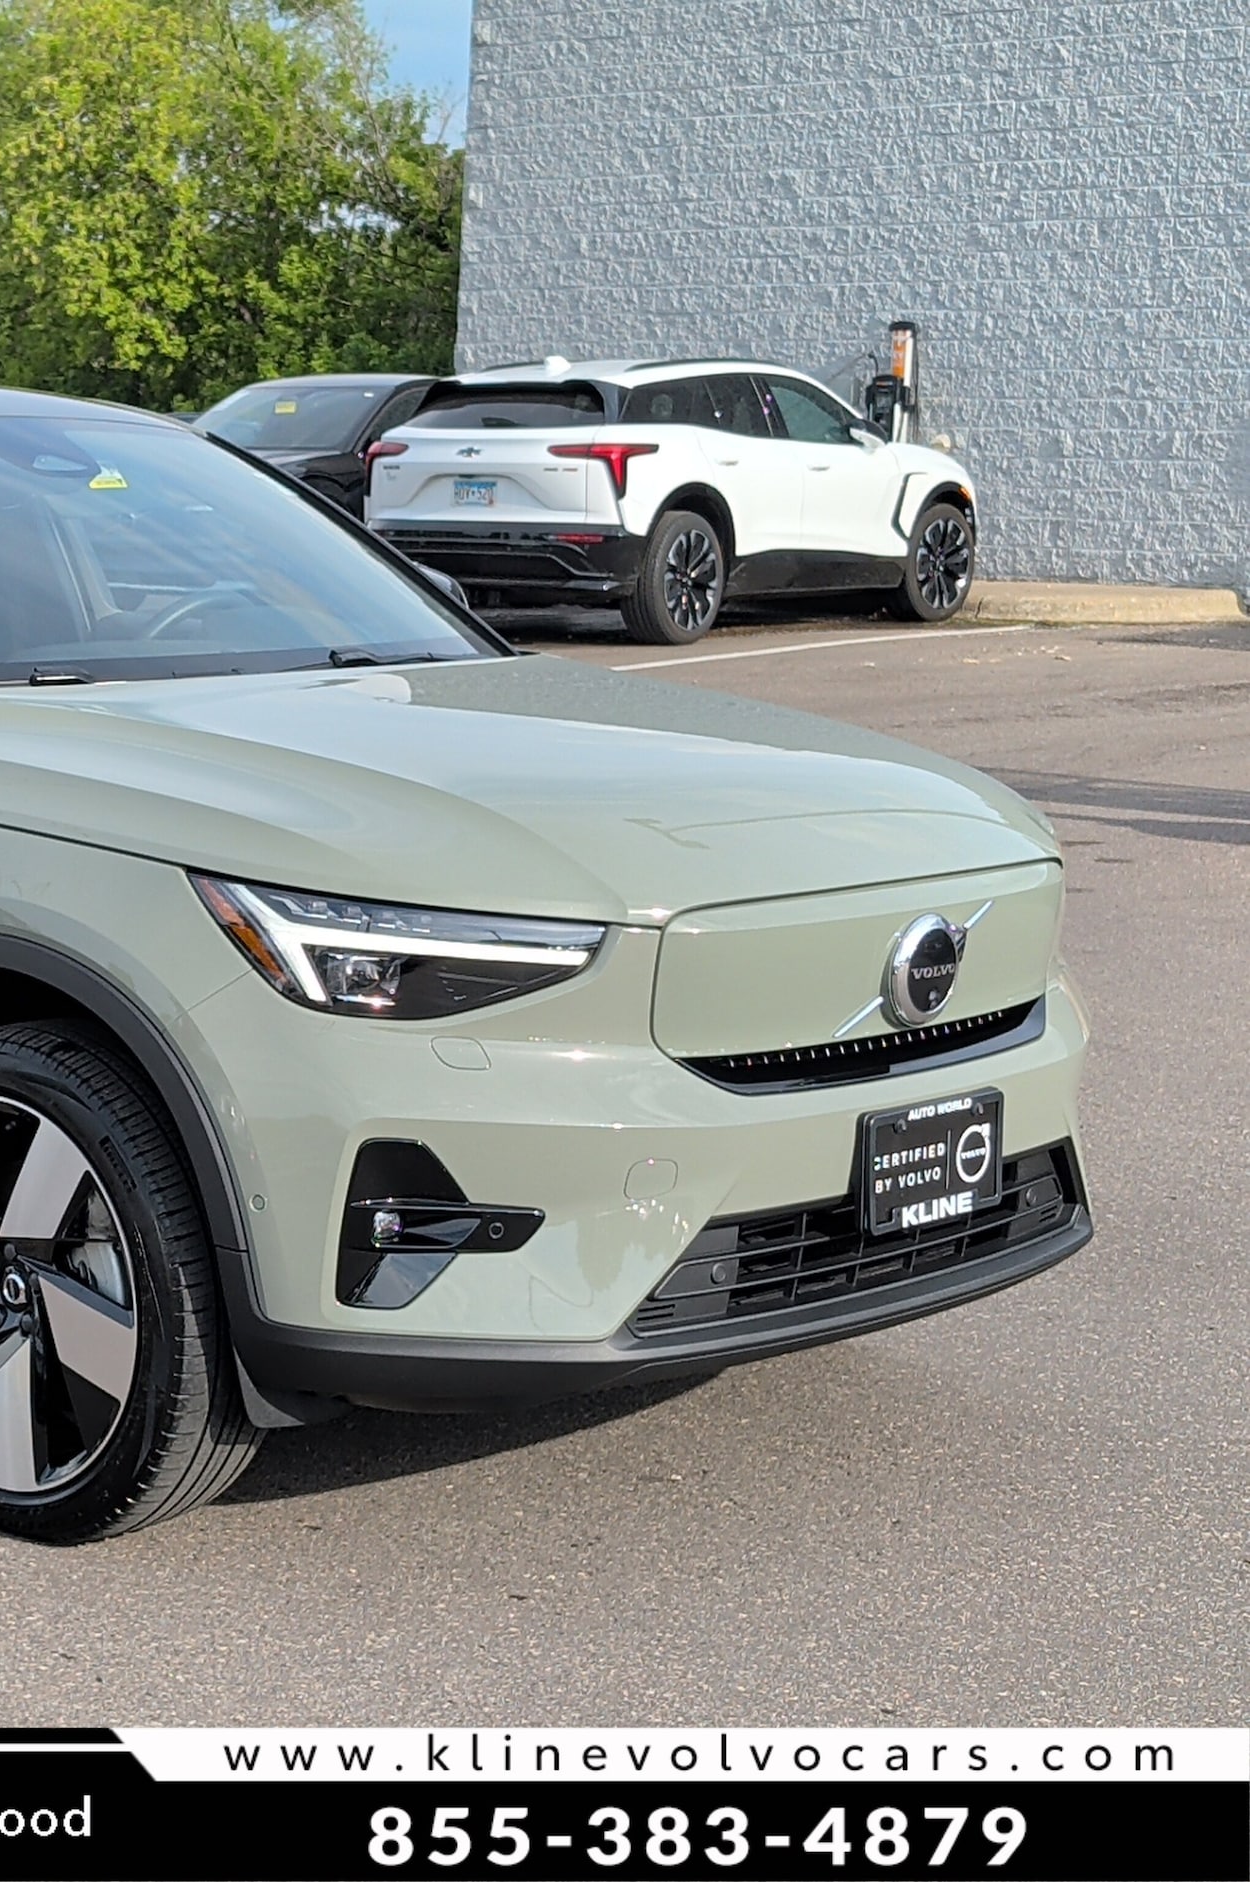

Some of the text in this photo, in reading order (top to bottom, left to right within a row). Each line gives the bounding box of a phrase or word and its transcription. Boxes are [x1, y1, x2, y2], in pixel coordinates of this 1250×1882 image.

[911, 963, 956, 979] VOLVO
[908, 1098, 972, 1121] AUTO WORLD
[873, 1142, 946, 1171] CERTIFIED
[875, 1166, 942, 1194] BY VOLVO
[901, 1191, 973, 1228] KLINE
